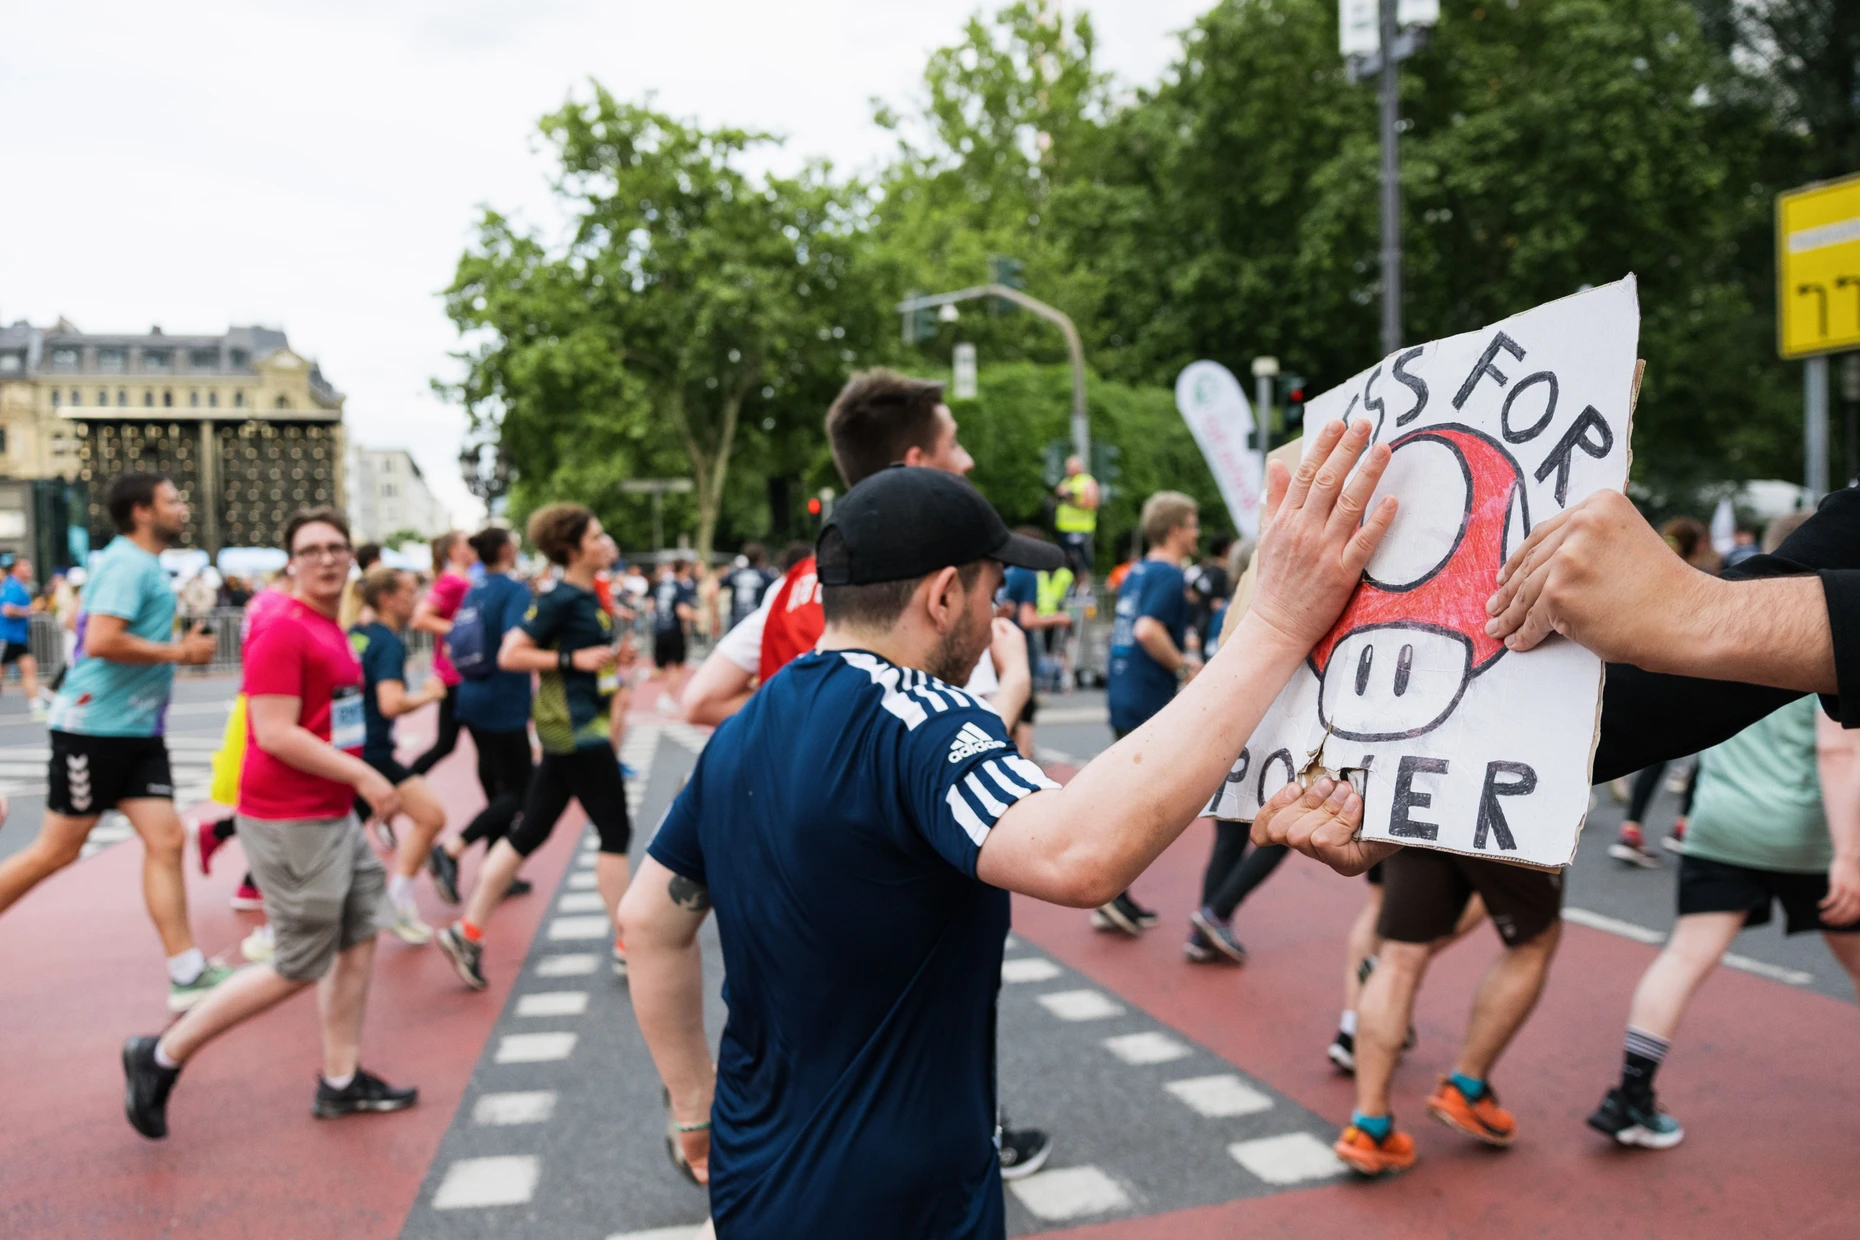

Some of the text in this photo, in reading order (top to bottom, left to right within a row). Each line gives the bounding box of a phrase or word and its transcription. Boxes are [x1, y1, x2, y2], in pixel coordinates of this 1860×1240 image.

[1452, 331, 1613, 508] FOR
[948, 740, 1006, 763] adidas
[1209, 746, 1538, 850] POER
